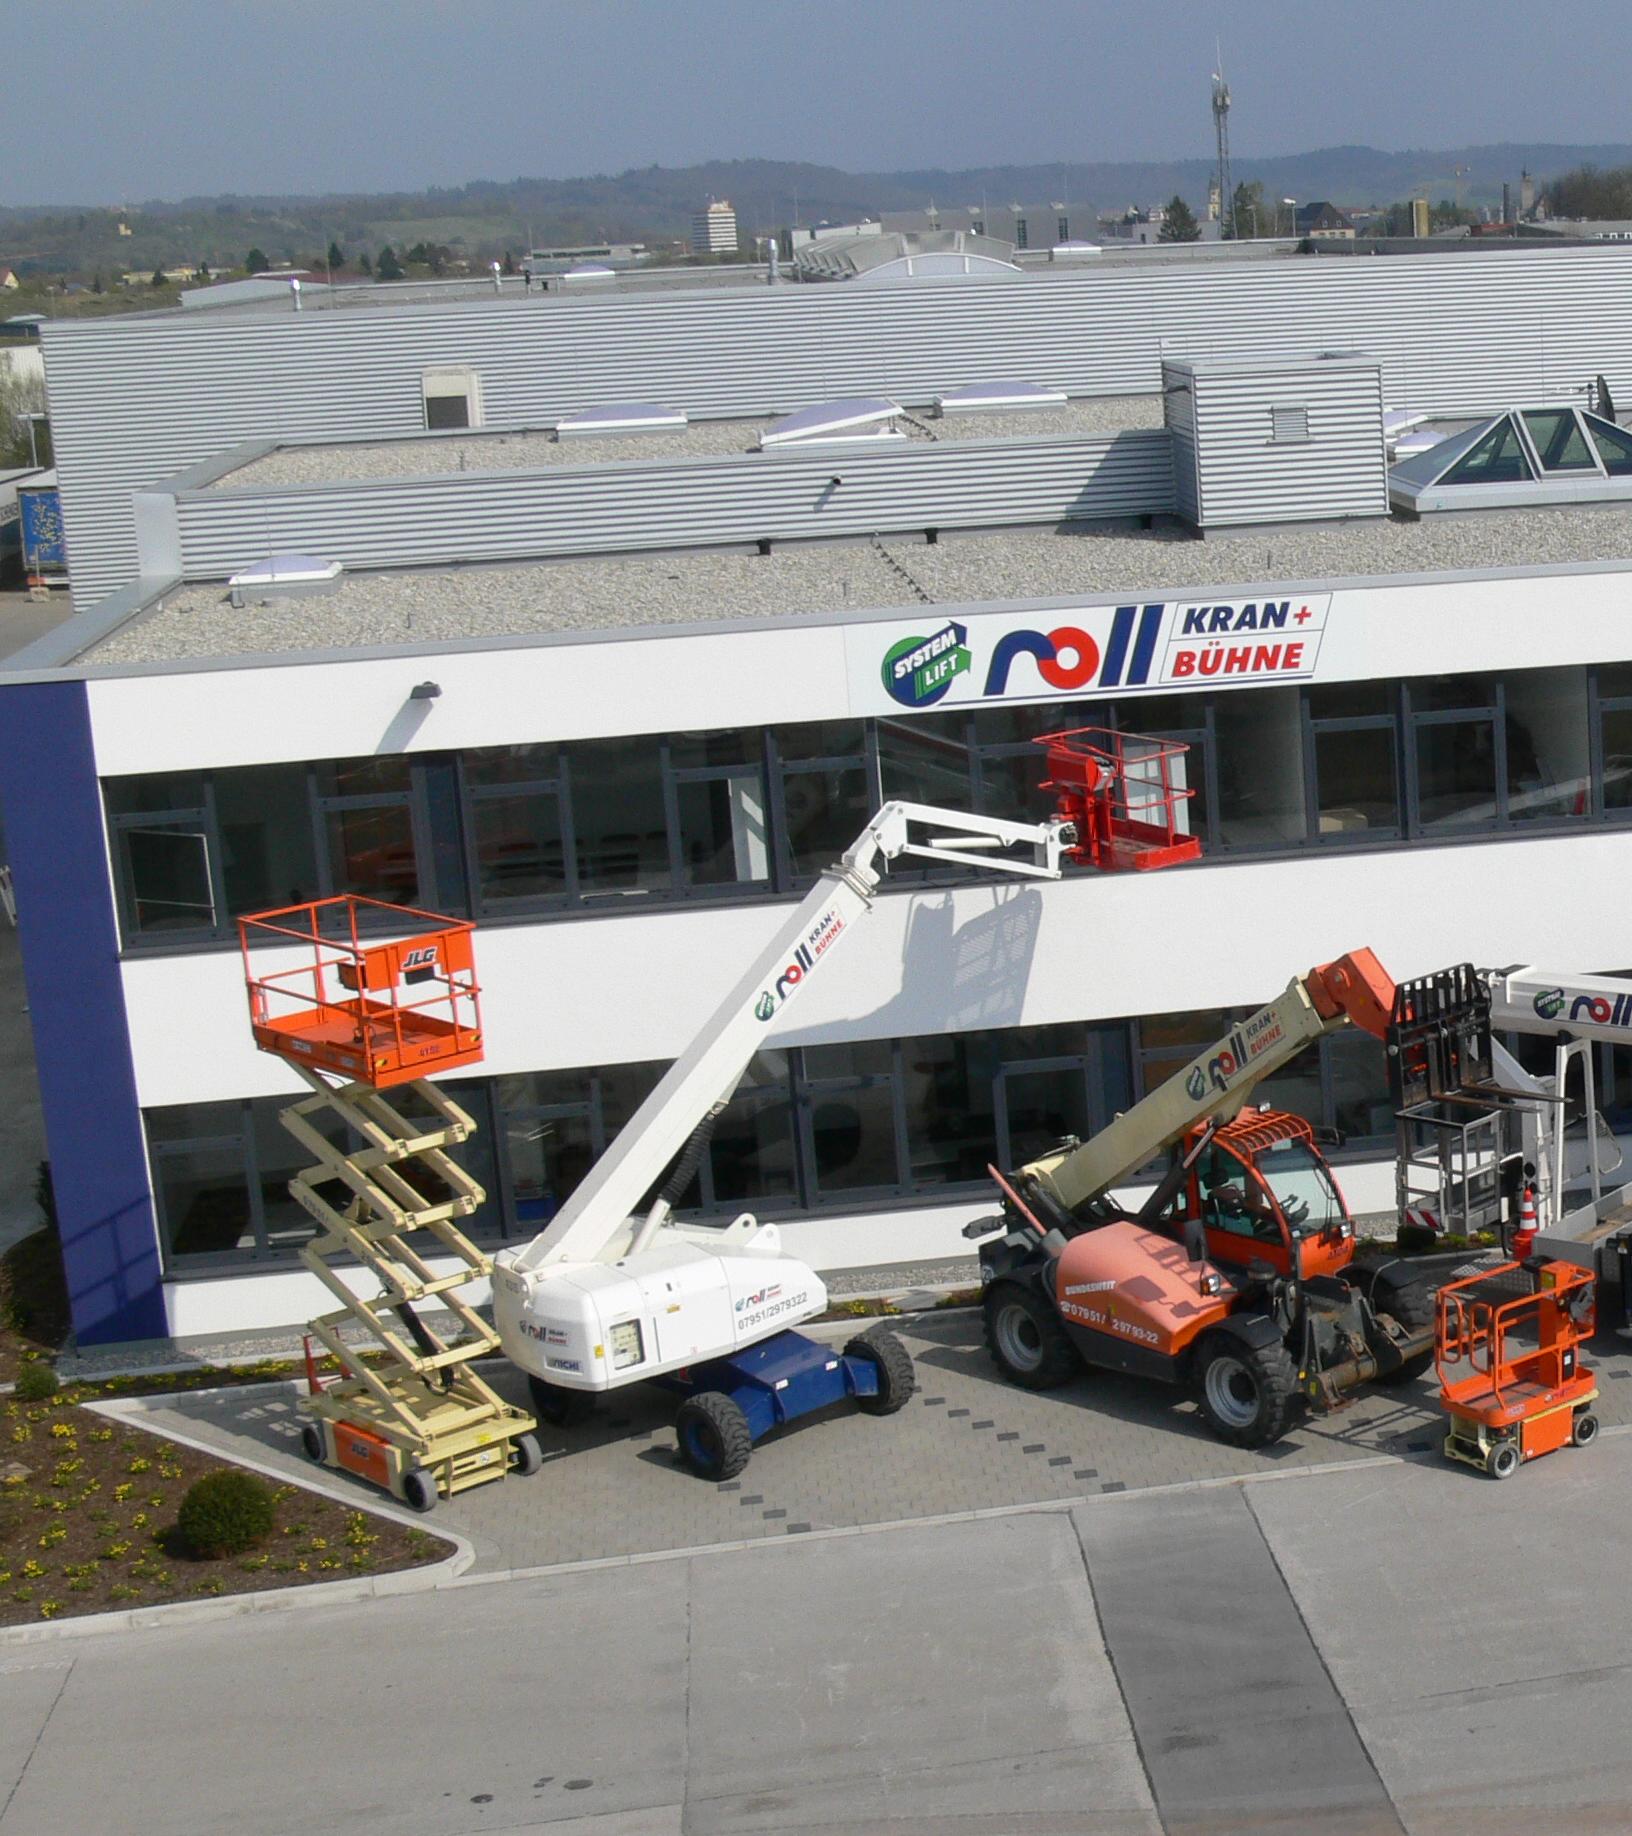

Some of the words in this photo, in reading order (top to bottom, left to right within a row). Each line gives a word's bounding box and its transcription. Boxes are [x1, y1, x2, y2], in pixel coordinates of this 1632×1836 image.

[894, 629, 958, 679] SYSTEM
[983, 604, 1165, 696] roll
[1171, 641, 1304, 678] BÜHNE
[925, 654, 959, 686] LIFT
[403, 949, 437, 968] JLG
[738, 1291, 808, 1330] 07951/2979322
